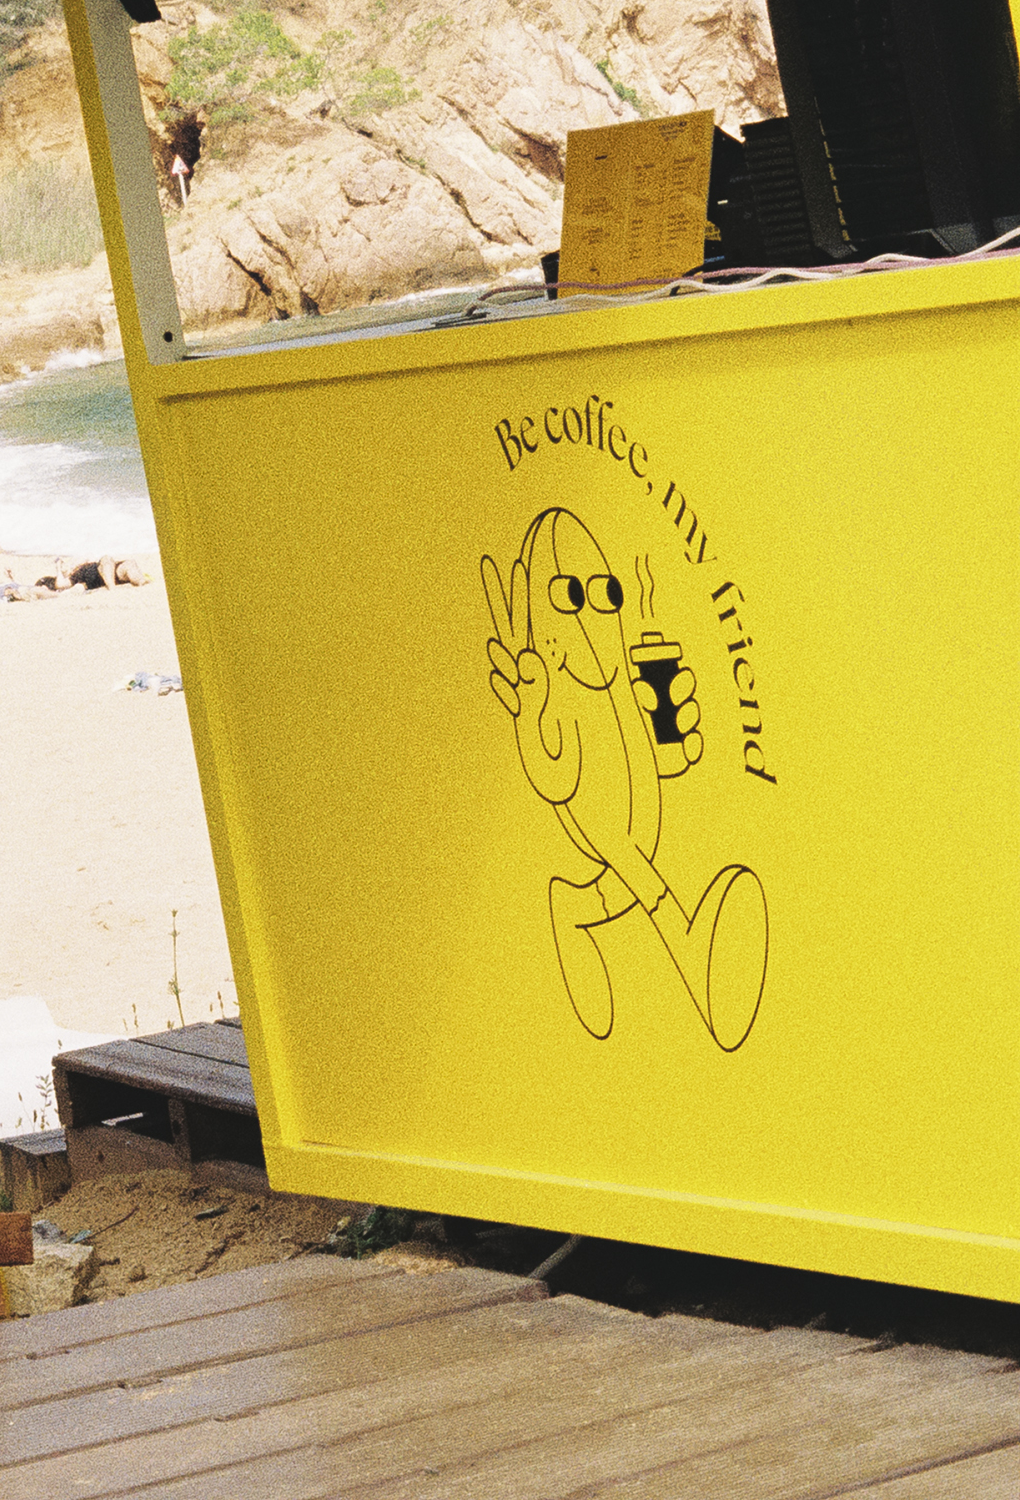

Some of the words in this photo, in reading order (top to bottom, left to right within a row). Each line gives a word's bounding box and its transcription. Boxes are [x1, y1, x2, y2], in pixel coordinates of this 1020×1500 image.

[494, 416, 538, 471] Be
[544, 395, 653, 495] coffee,
[662, 481, 717, 564] my
[711, 581, 778, 785] friend
